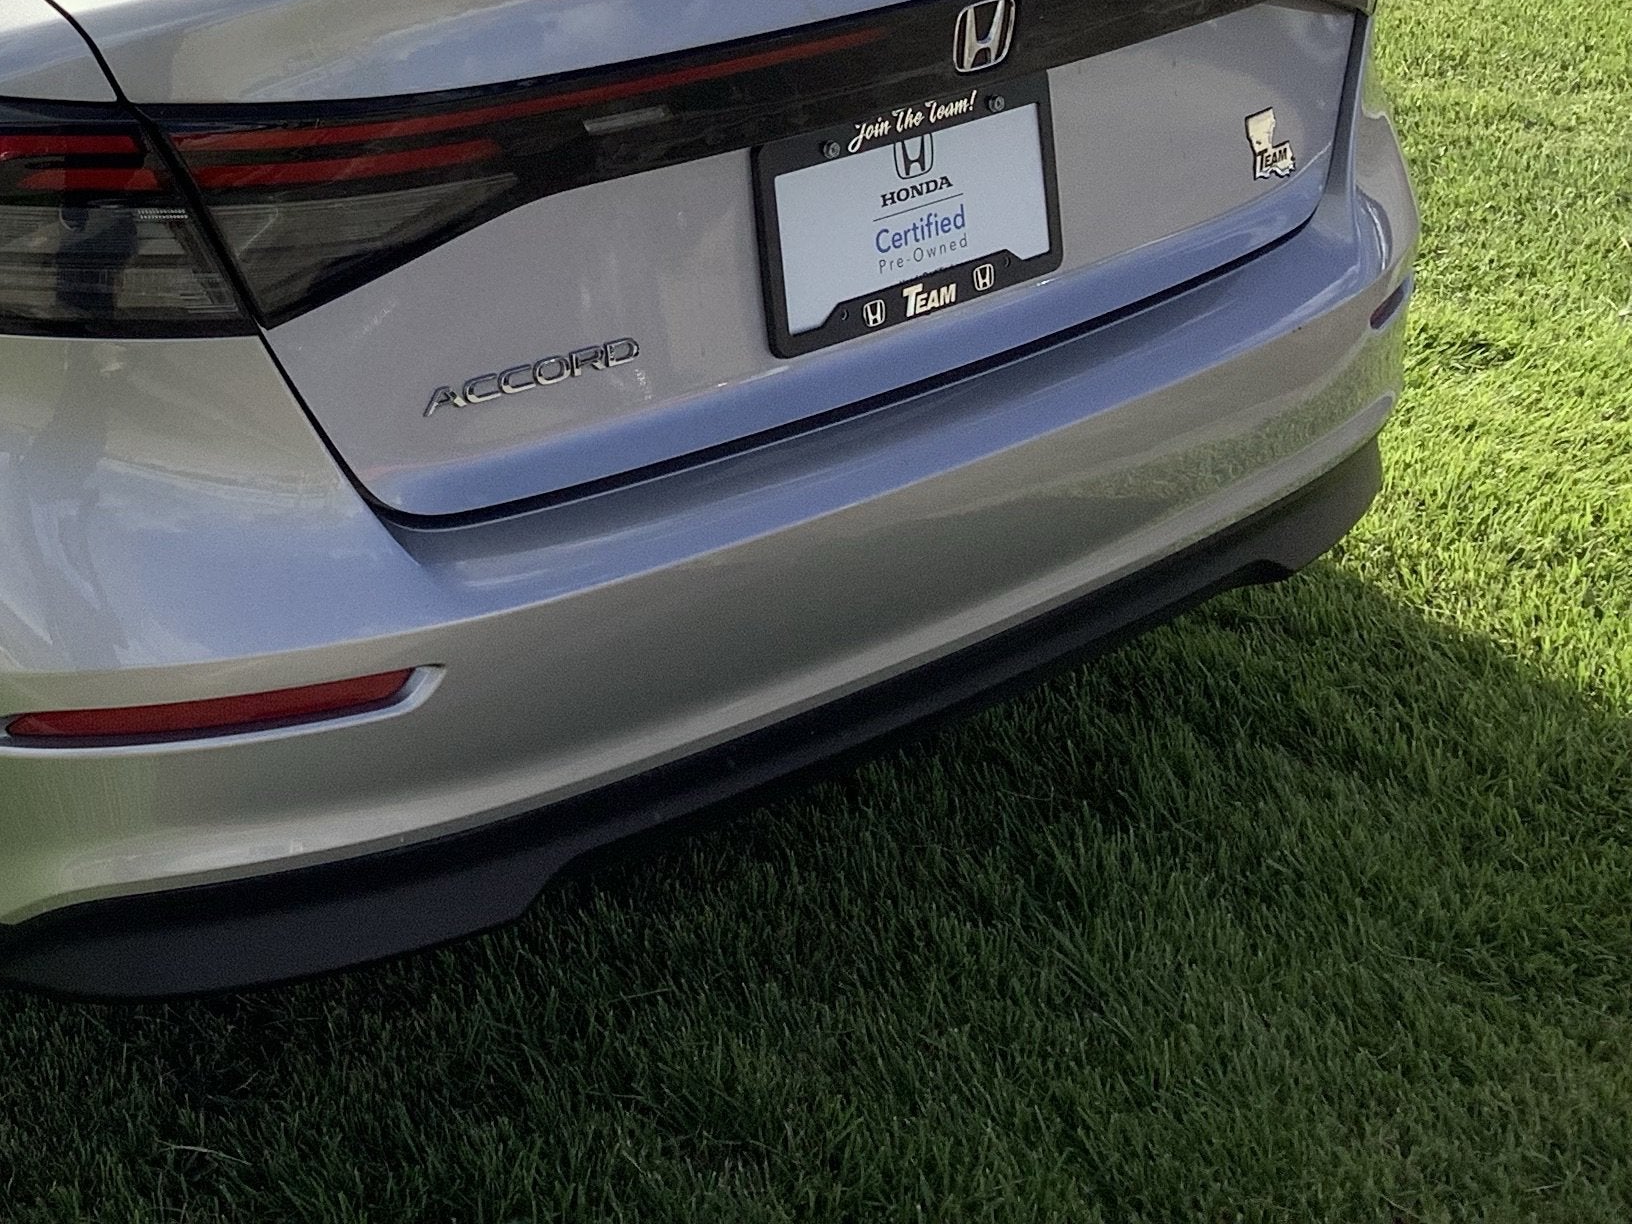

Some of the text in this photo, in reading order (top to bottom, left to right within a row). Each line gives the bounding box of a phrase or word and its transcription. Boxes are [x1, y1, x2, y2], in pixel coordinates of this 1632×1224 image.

[847, 117, 892, 153] Join
[880, 175, 954, 208] HONDA
[875, 203, 967, 254] Certified
[878, 233, 969, 274] Pre-Owned
[423, 337, 640, 418] ACCORD
